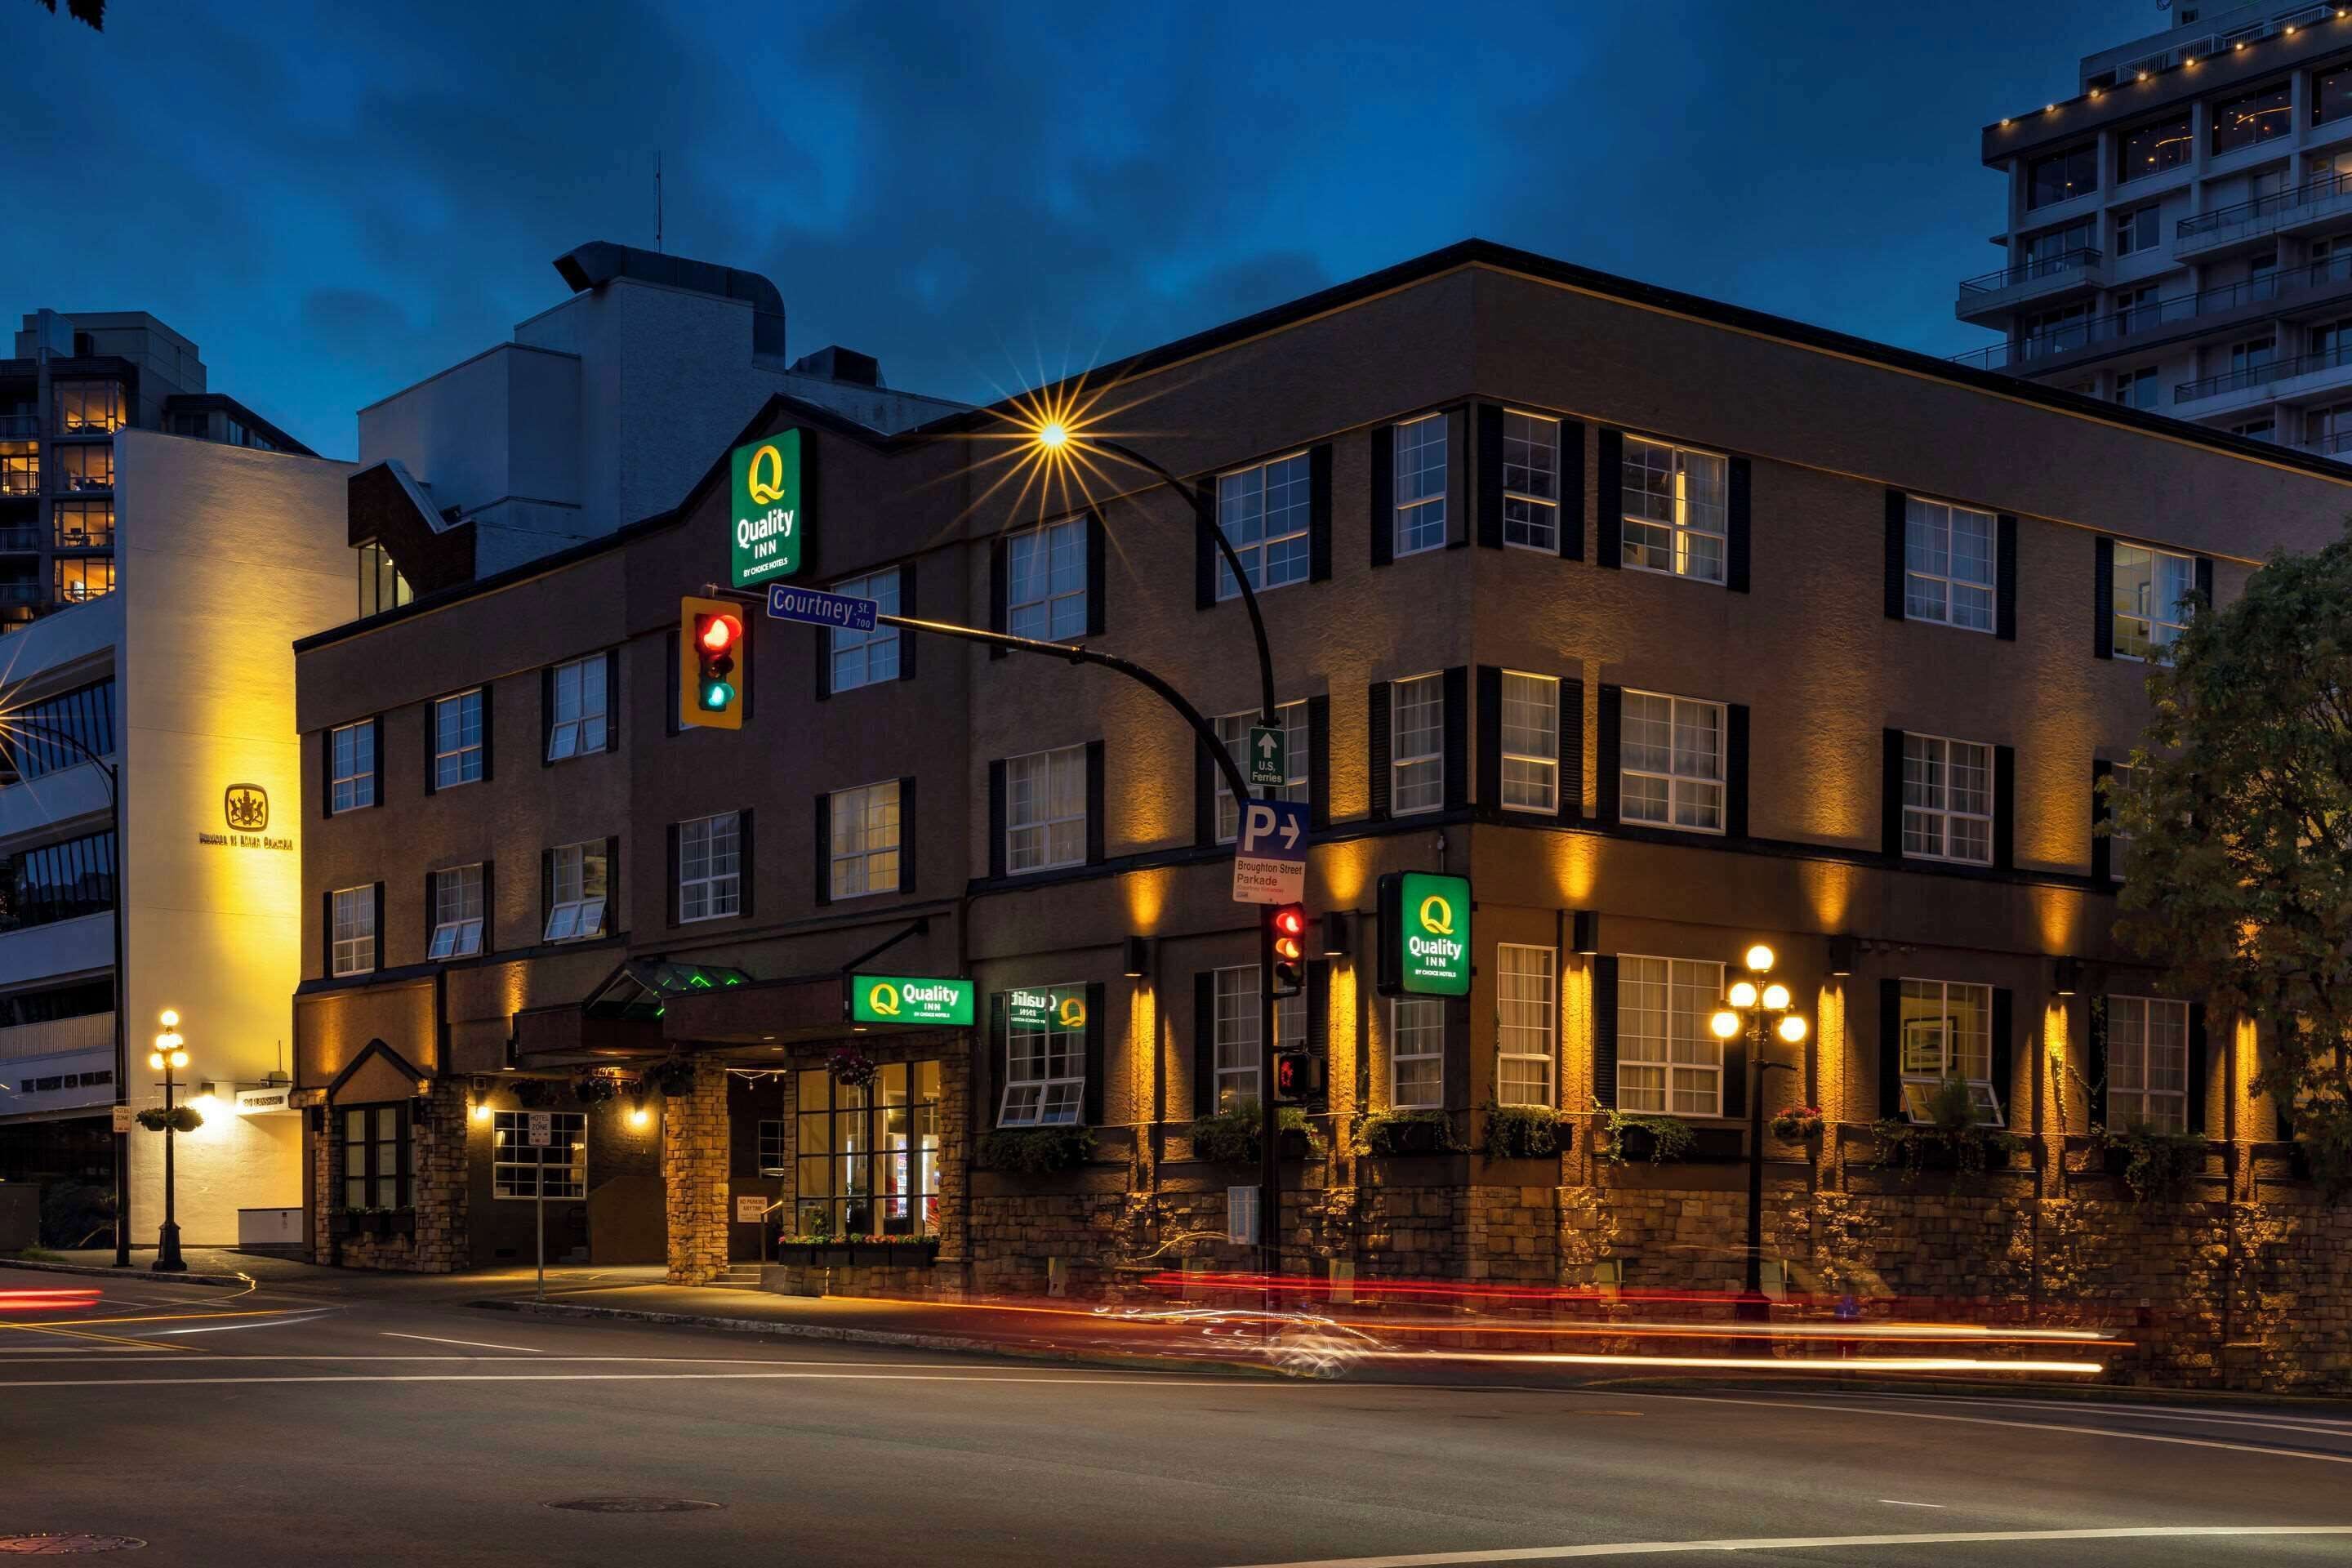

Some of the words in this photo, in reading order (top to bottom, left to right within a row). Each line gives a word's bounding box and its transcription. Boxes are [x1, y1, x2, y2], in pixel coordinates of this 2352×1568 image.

[749, 445, 785, 505] Q
[737, 508, 795, 549] Quality
[755, 539, 777, 559] INN
[743, 568, 751, 577] BY
[751, 563, 769, 575] CHOICE
[768, 557, 788, 569] HOTELS
[773, 590, 853, 626] Courtney
[858, 602, 870, 614] St.
[1252, 772, 1282, 783] Ferries
[1244, 804, 1276, 852] P
[1238, 860, 1277, 874] Broughton
[1280, 863, 1303, 875] Street
[1237, 874, 1277, 886] Parkade
[1420, 896, 1454, 934] Q
[1409, 936, 1462, 960] Quality
[1426, 956, 1446, 967] INN
[870, 983, 901, 1015] Q
[902, 983, 959, 1006] Quality
